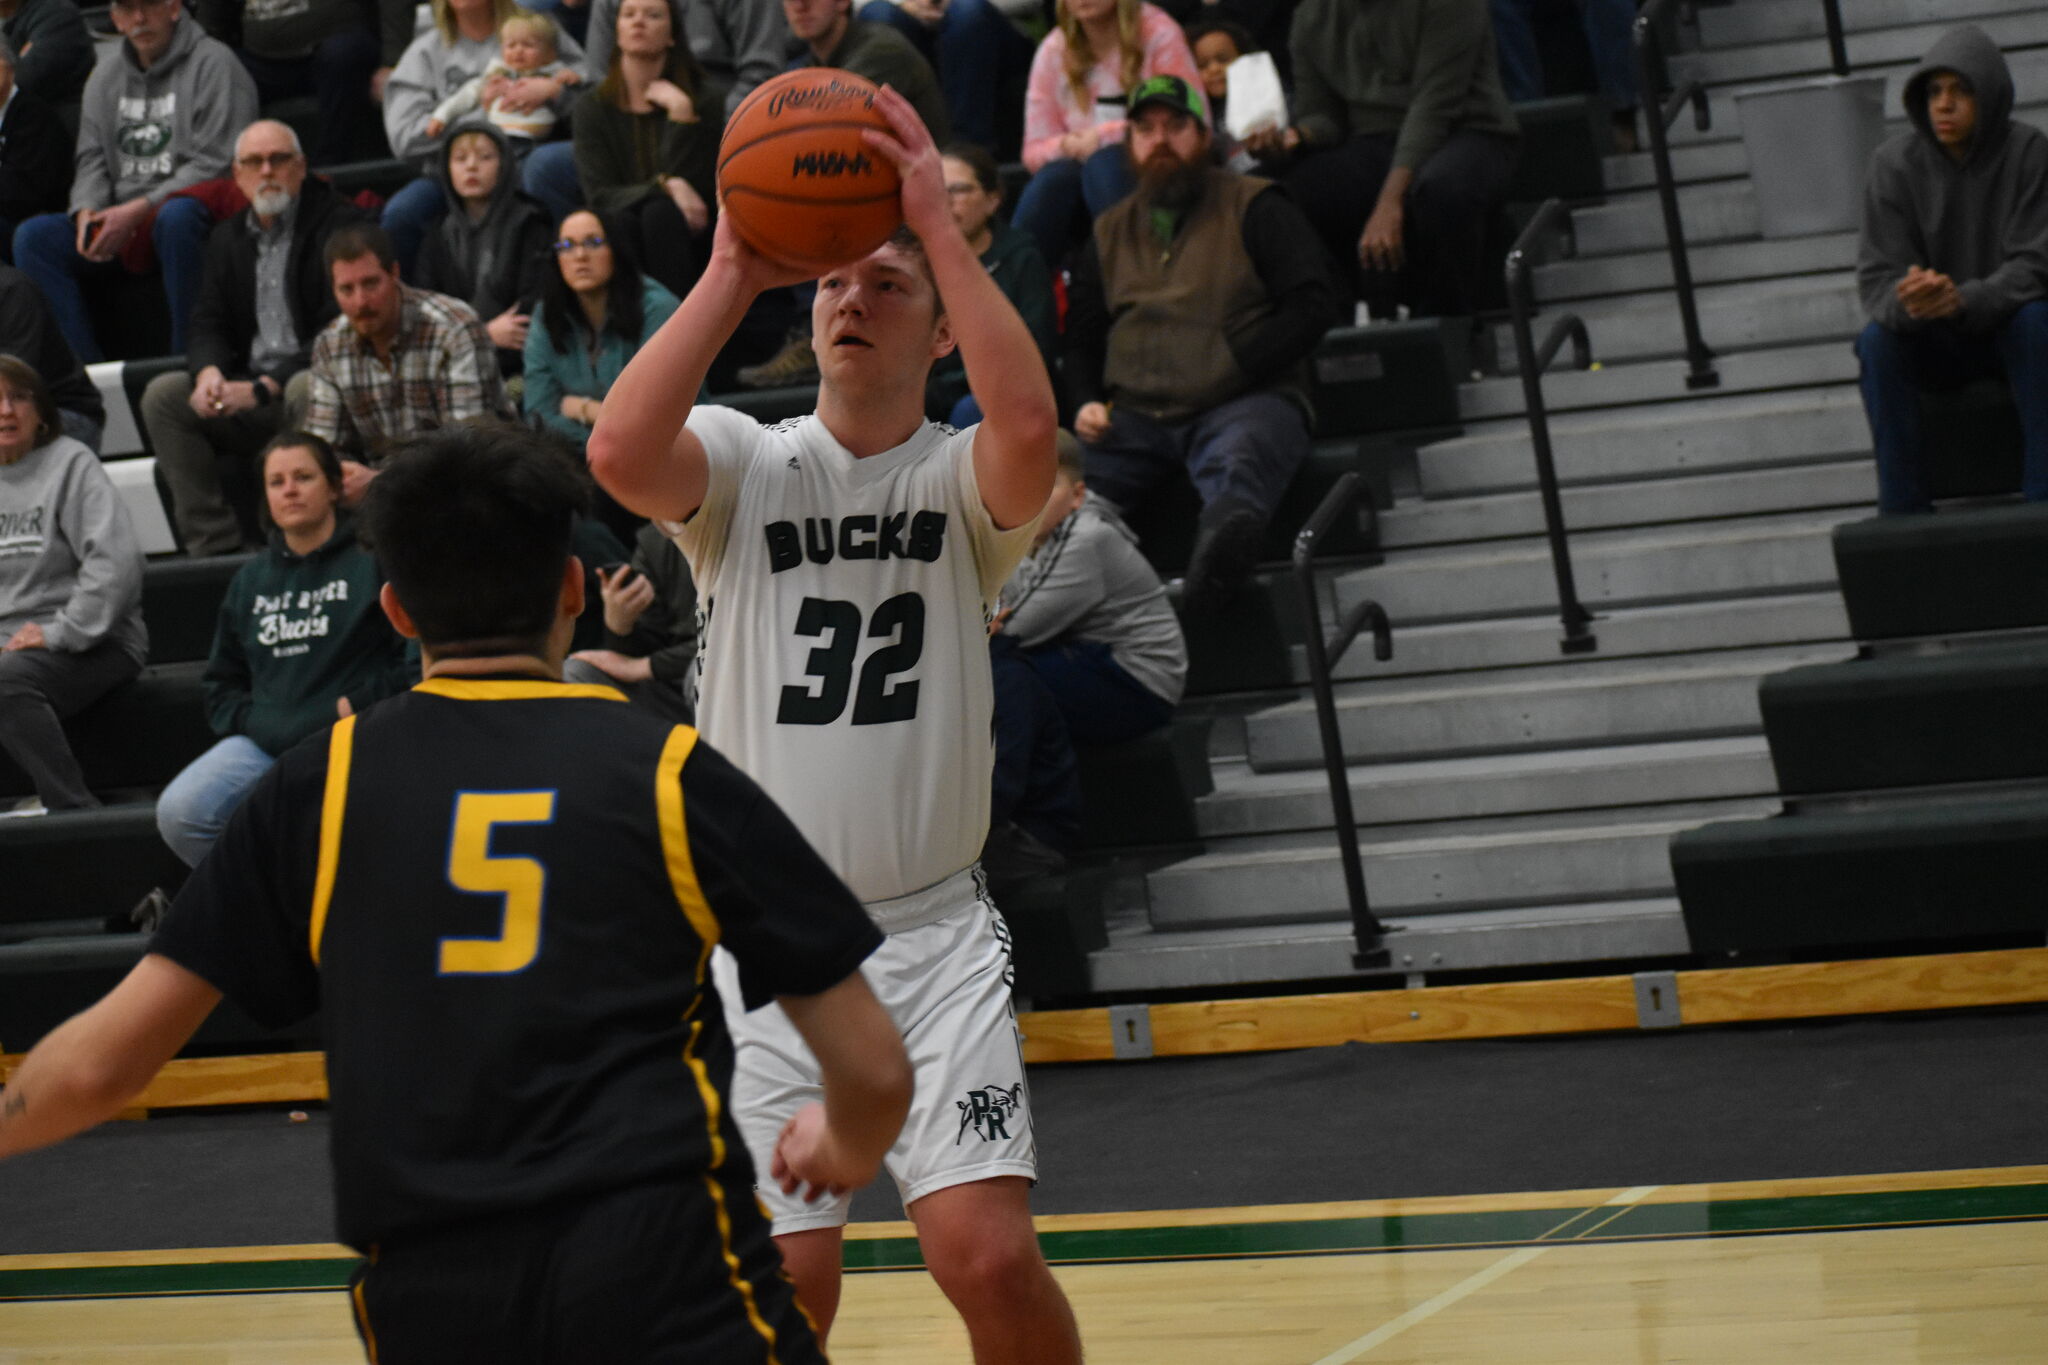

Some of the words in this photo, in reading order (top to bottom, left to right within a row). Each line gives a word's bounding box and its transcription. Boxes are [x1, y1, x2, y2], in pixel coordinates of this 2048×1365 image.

[767, 79, 876, 119] Rawling
[765, 510, 947, 574] BUCKS
[776, 591, 925, 726] 32
[436, 788, 559, 978] 5
